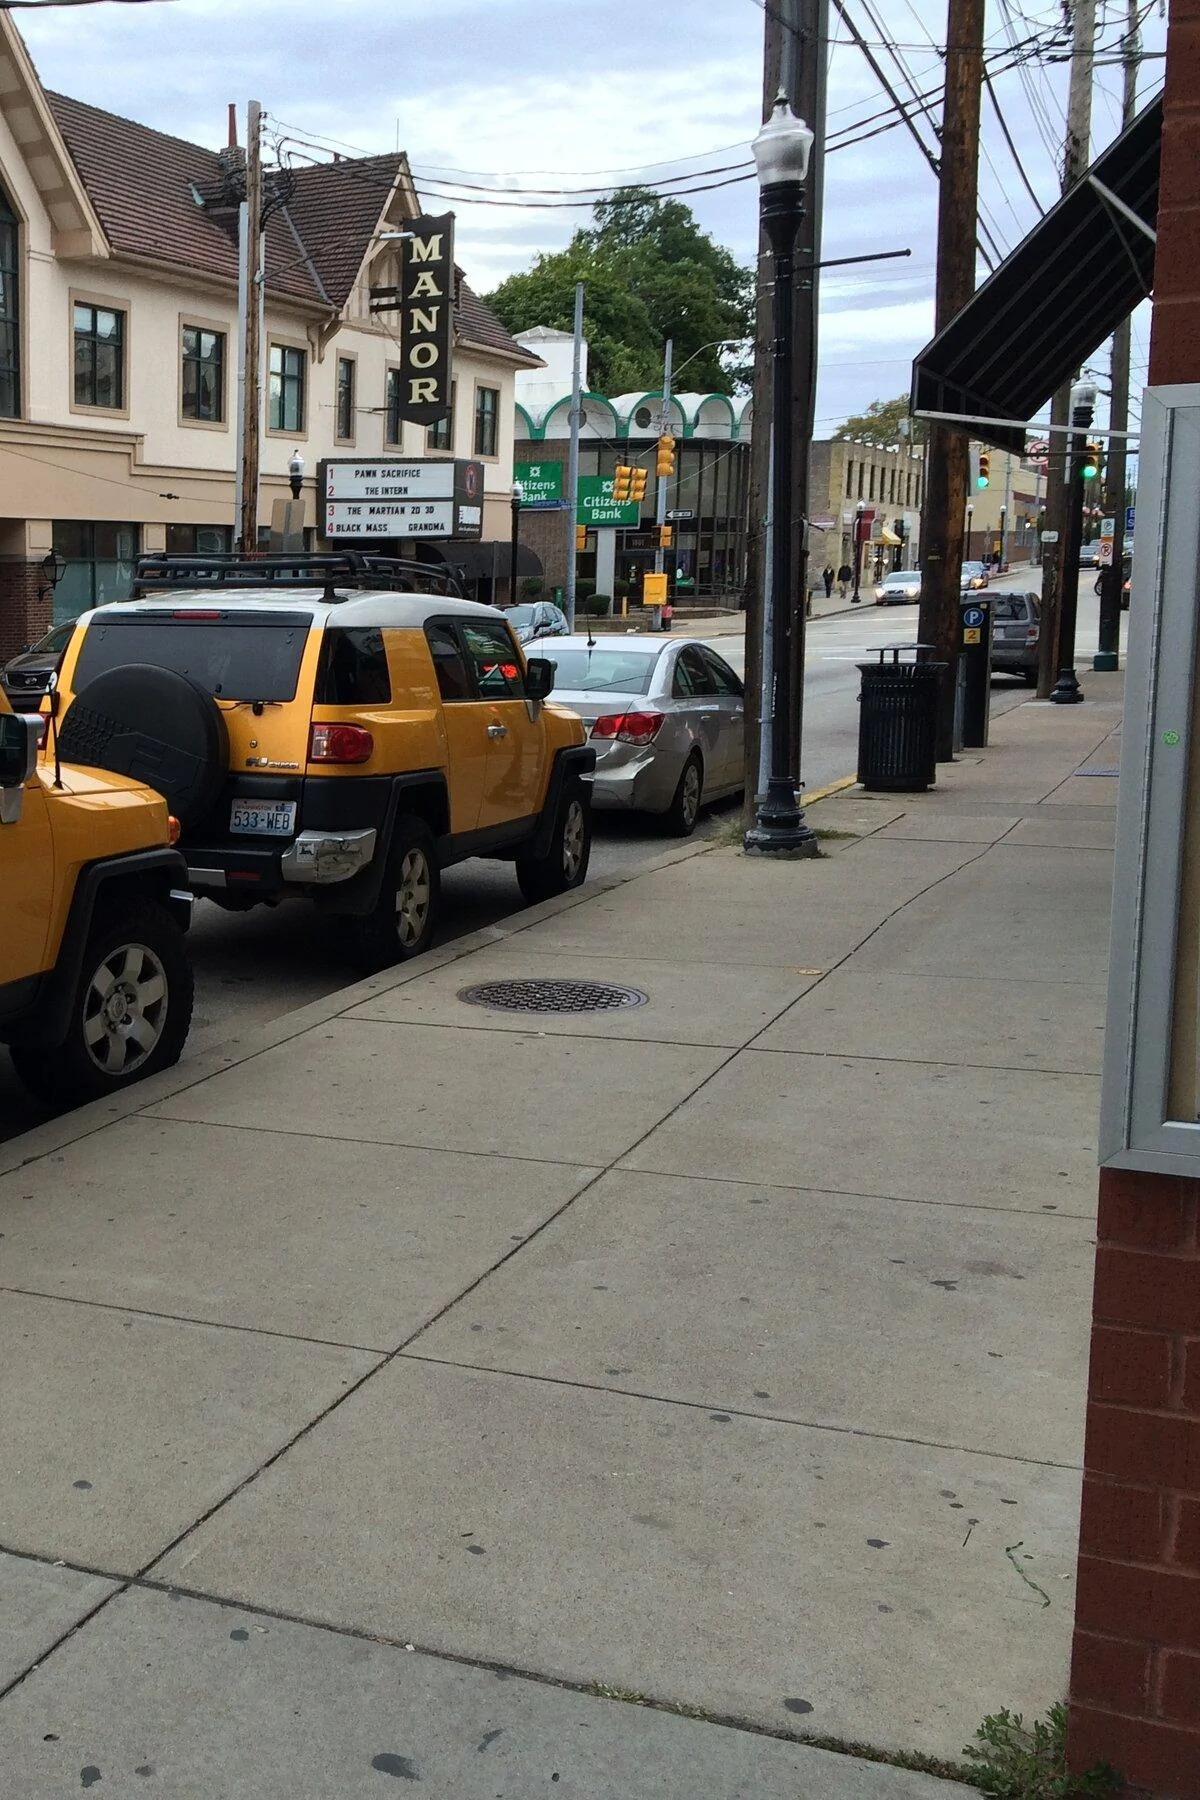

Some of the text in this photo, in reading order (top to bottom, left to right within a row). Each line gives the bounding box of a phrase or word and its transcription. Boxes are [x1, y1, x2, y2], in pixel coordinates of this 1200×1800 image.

[408, 233, 444, 404] MANOR
[354, 469, 377, 478] PAWN
[381, 468, 421, 478] SACRIFICE
[516, 479, 556, 490] tizens
[365, 486, 379, 495] THE
[381, 486, 409, 495] INTERN
[521, 490, 547, 502] Bank
[347, 506, 361, 515] THE
[369, 506, 405, 515] MARTIAN
[425, 505, 435, 514] 3D
[591, 508, 622, 520] Bank
[336, 523, 361, 532] BLACK
[366, 523, 388, 532] MASS
[408, 523, 445, 532] GRANDMA
[967, 630, 977, 640] 2
[233, 810, 290, 830] 533-WEB
